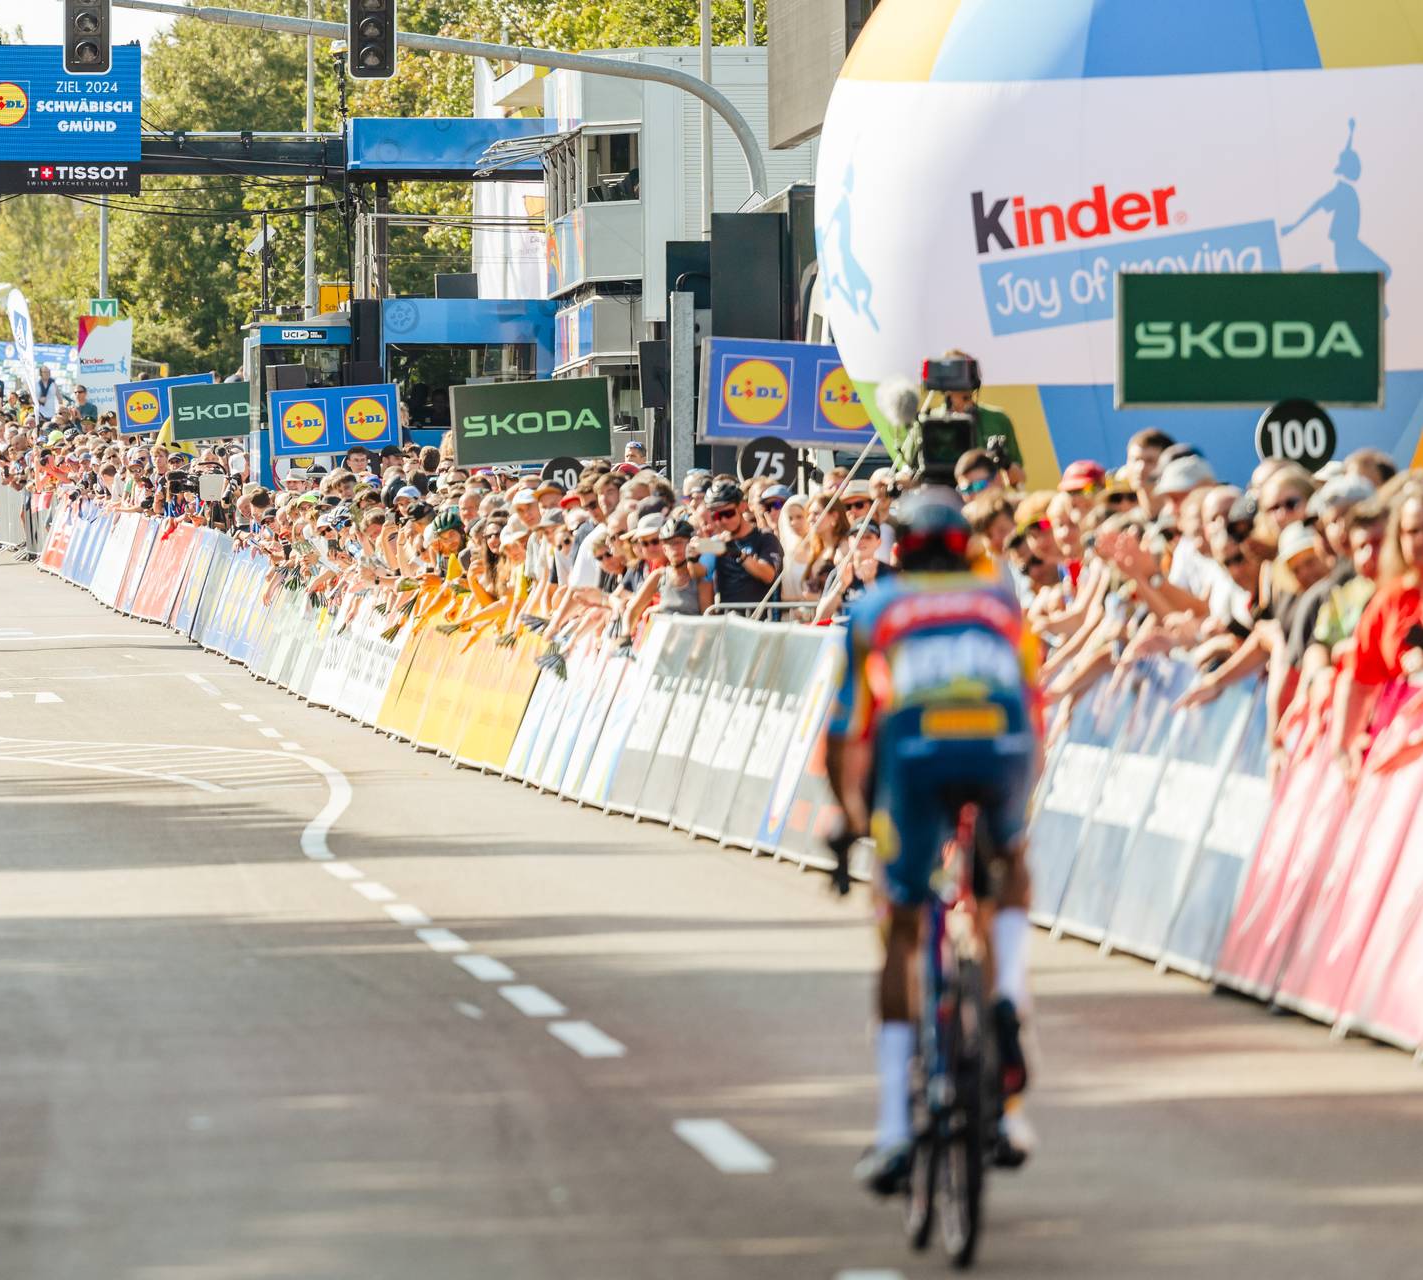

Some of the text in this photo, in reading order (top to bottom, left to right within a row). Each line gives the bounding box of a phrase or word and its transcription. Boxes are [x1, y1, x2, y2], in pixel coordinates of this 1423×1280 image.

[56, 81, 118, 93] ZIEL 2024
[36, 98, 133, 113] SCHWÄBISCH
[57, 117, 117, 132] GMÜND
[55, 166, 128, 180] TISSOT
[283, 331, 300, 339] UCI
[178, 402, 251, 421] SKOD
[1266, 417, 1327, 459] 100
[753, 451, 786, 481] 75
